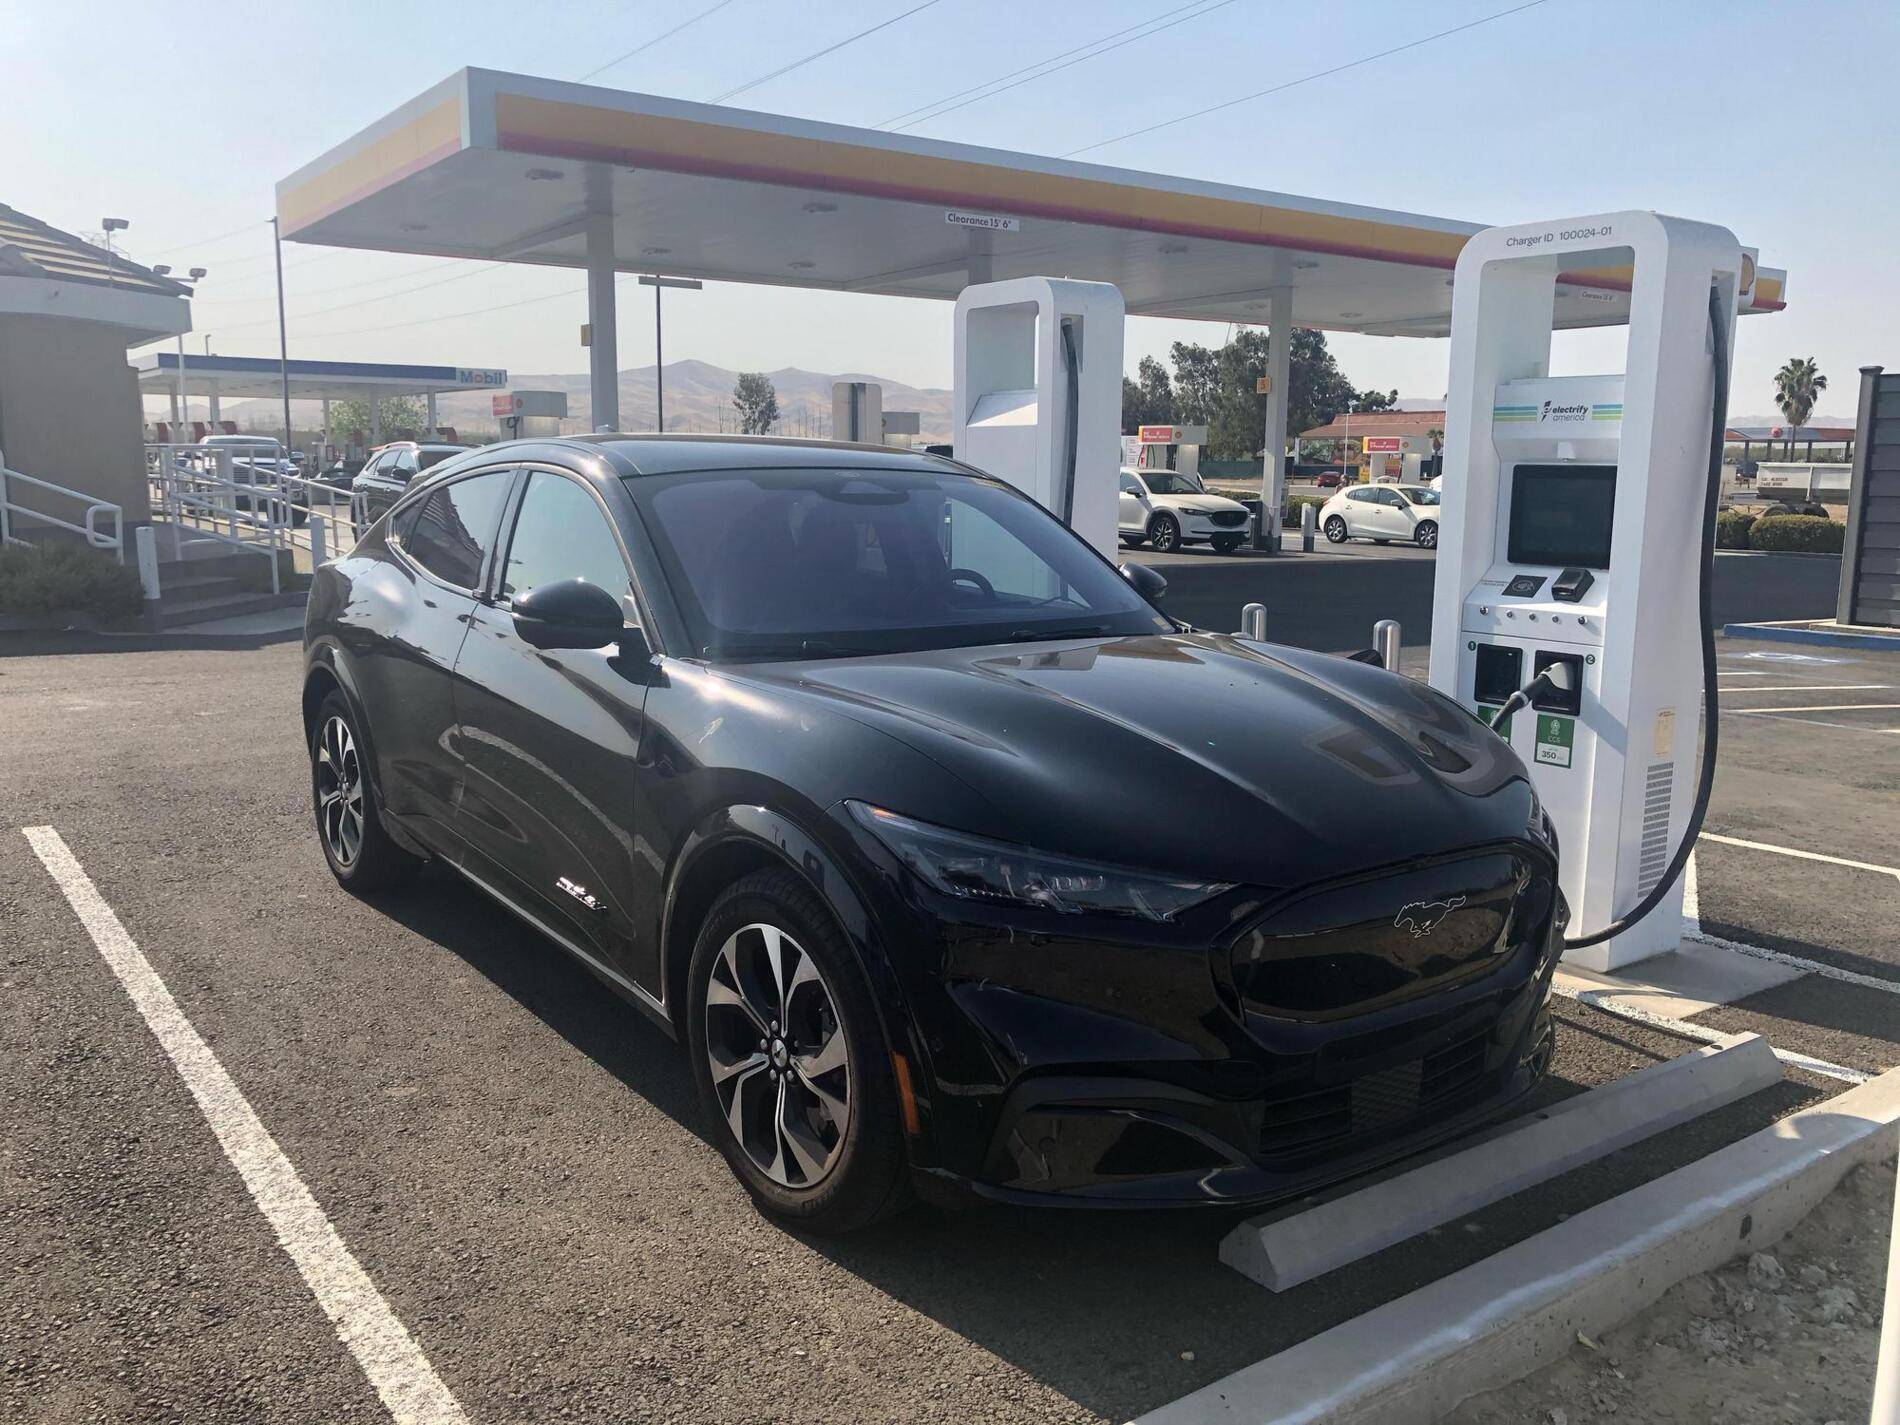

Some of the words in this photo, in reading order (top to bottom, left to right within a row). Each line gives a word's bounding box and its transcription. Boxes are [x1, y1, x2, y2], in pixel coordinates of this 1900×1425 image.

[947, 213, 989, 226] Clearance
[1506, 235, 1543, 247] Charger
[1544, 233, 1554, 243] ID
[1559, 226, 1612, 240] 100024-01
[460, 370, 502, 384] Mobil
[1552, 405, 1588, 415] electrify
[1541, 750, 1557, 759] 350
